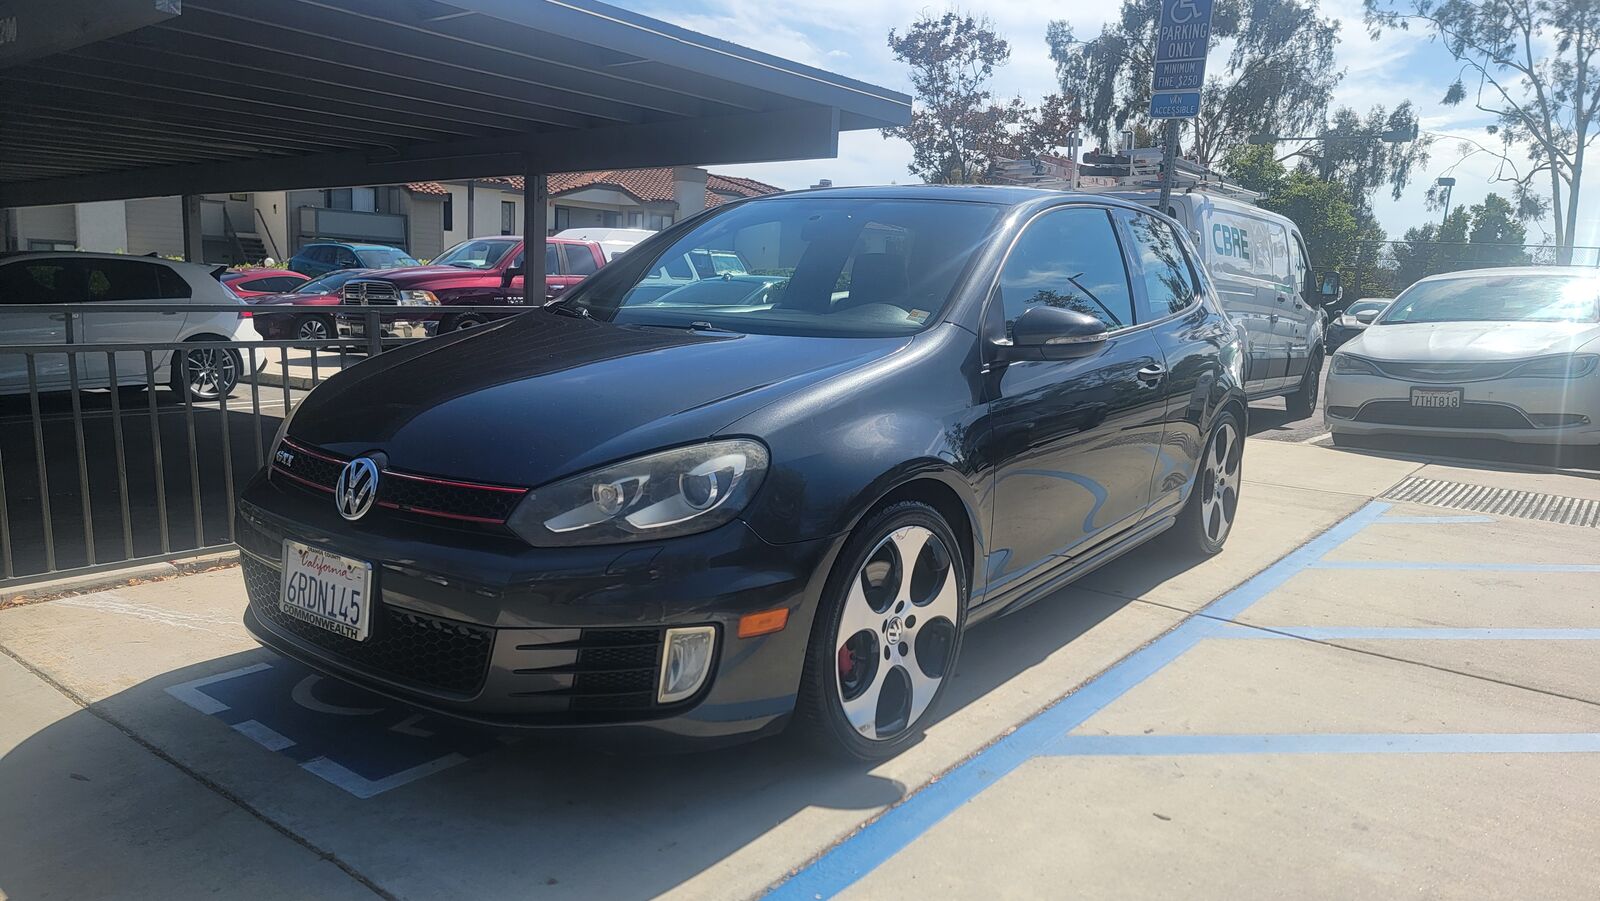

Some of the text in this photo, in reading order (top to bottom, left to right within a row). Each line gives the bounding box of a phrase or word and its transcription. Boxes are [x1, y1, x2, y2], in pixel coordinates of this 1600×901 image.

[1160, 22, 1207, 41] PARKING
[1168, 41, 1196, 58] ONLY
[1163, 62, 1196, 75] MINIMUM
[1158, 75, 1198, 87] FINE $250
[1169, 95, 1183, 104] VAN
[1154, 105, 1195, 115] ACCESSIBLE
[1212, 223, 1250, 260] CBRE
[276, 450, 294, 467] GTI
[300, 550, 349, 578] California
[287, 571, 361, 626] 6RDN145
[283, 603, 358, 640] COMMONWEALTH
